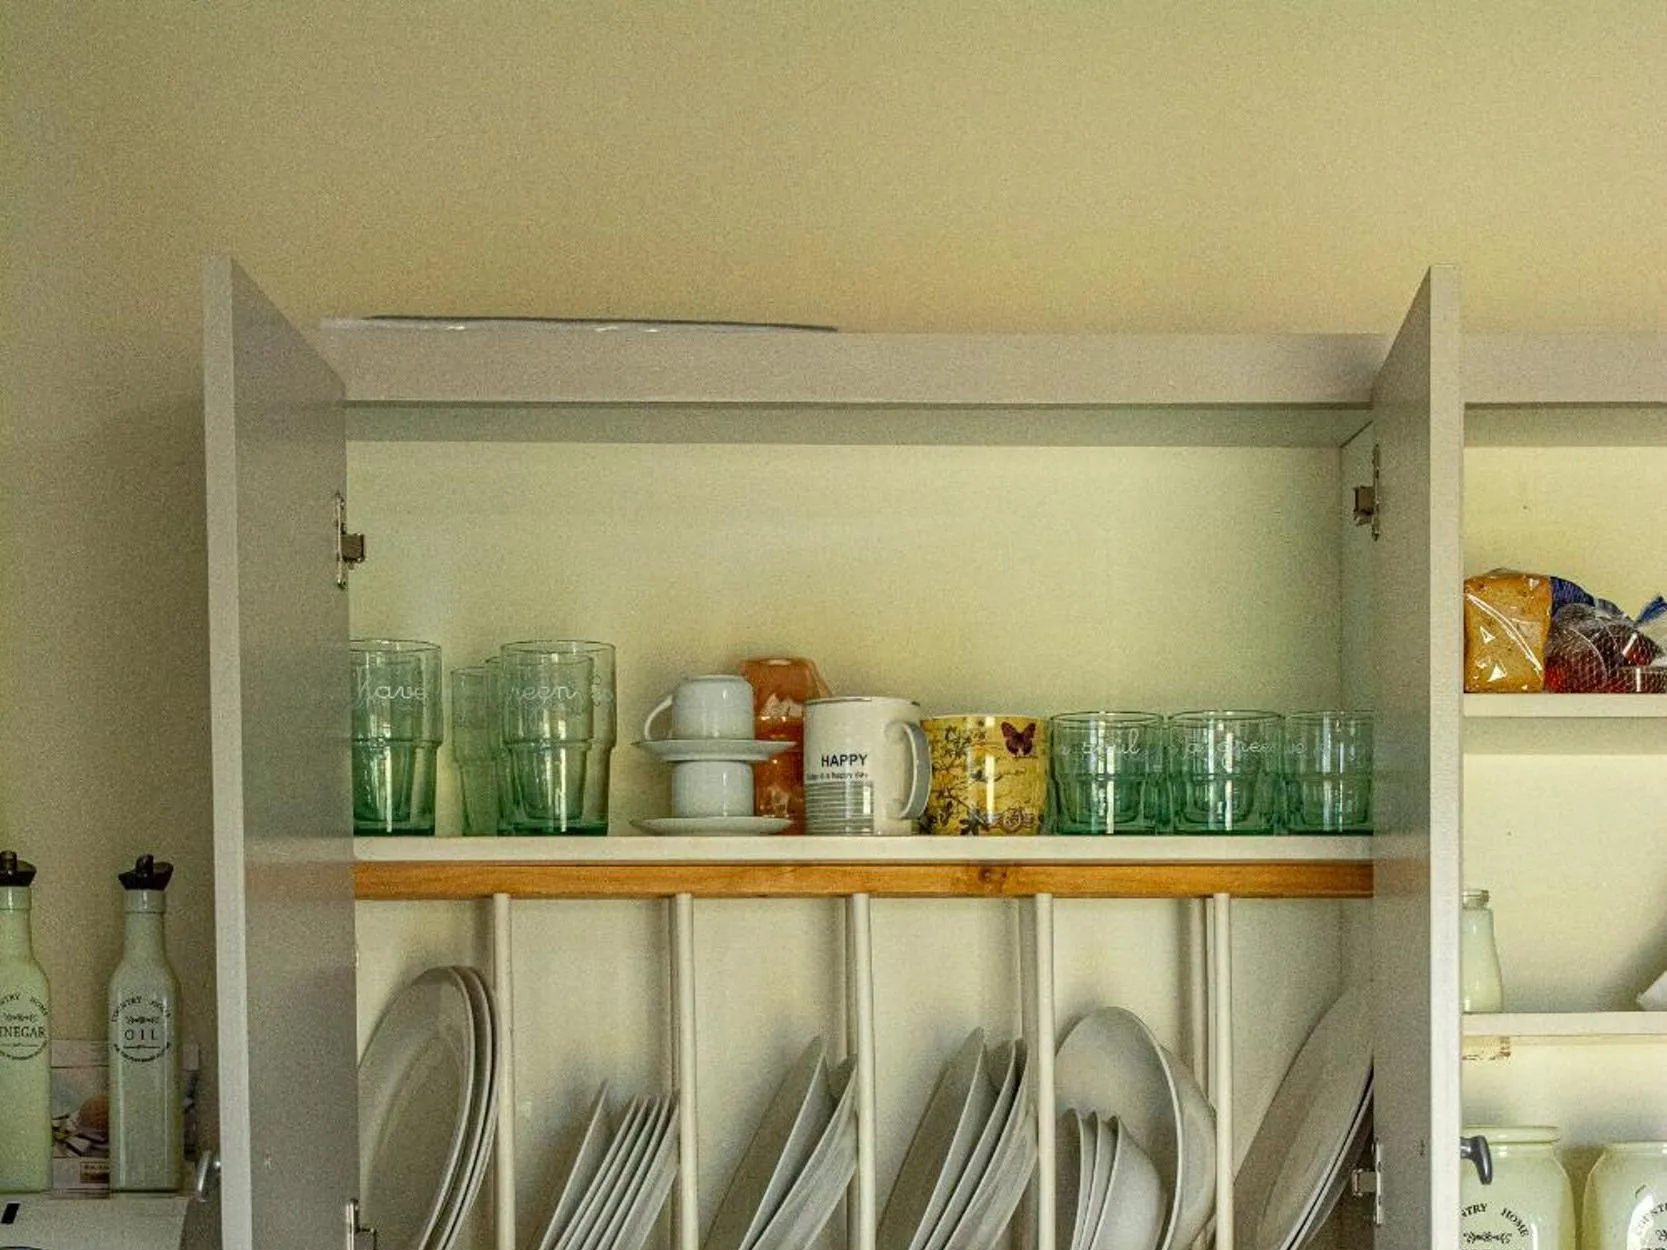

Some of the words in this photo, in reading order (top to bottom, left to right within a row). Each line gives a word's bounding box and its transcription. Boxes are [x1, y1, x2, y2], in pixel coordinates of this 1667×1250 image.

[821, 753, 868, 767] HAPPY
[124, 1029, 160, 1040] OIL
[1500, 1208, 1529, 1237] HOME
